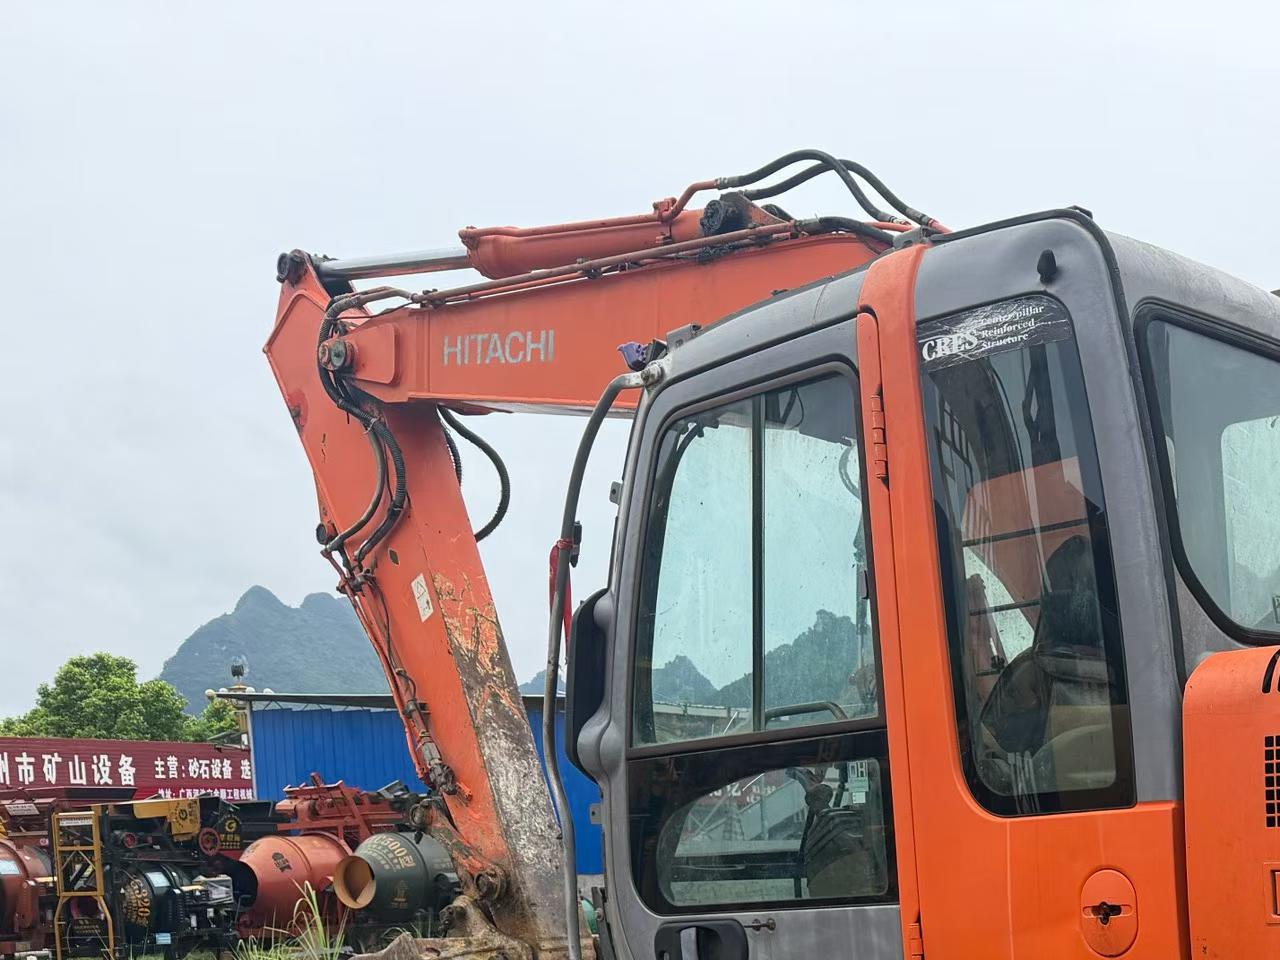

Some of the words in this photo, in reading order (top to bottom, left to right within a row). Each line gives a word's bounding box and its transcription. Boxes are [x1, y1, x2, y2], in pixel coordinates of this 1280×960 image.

[922, 328, 978, 362] CRES
[981, 318, 1035, 339] Reinforced
[442, 329, 555, 367] HITACHI
